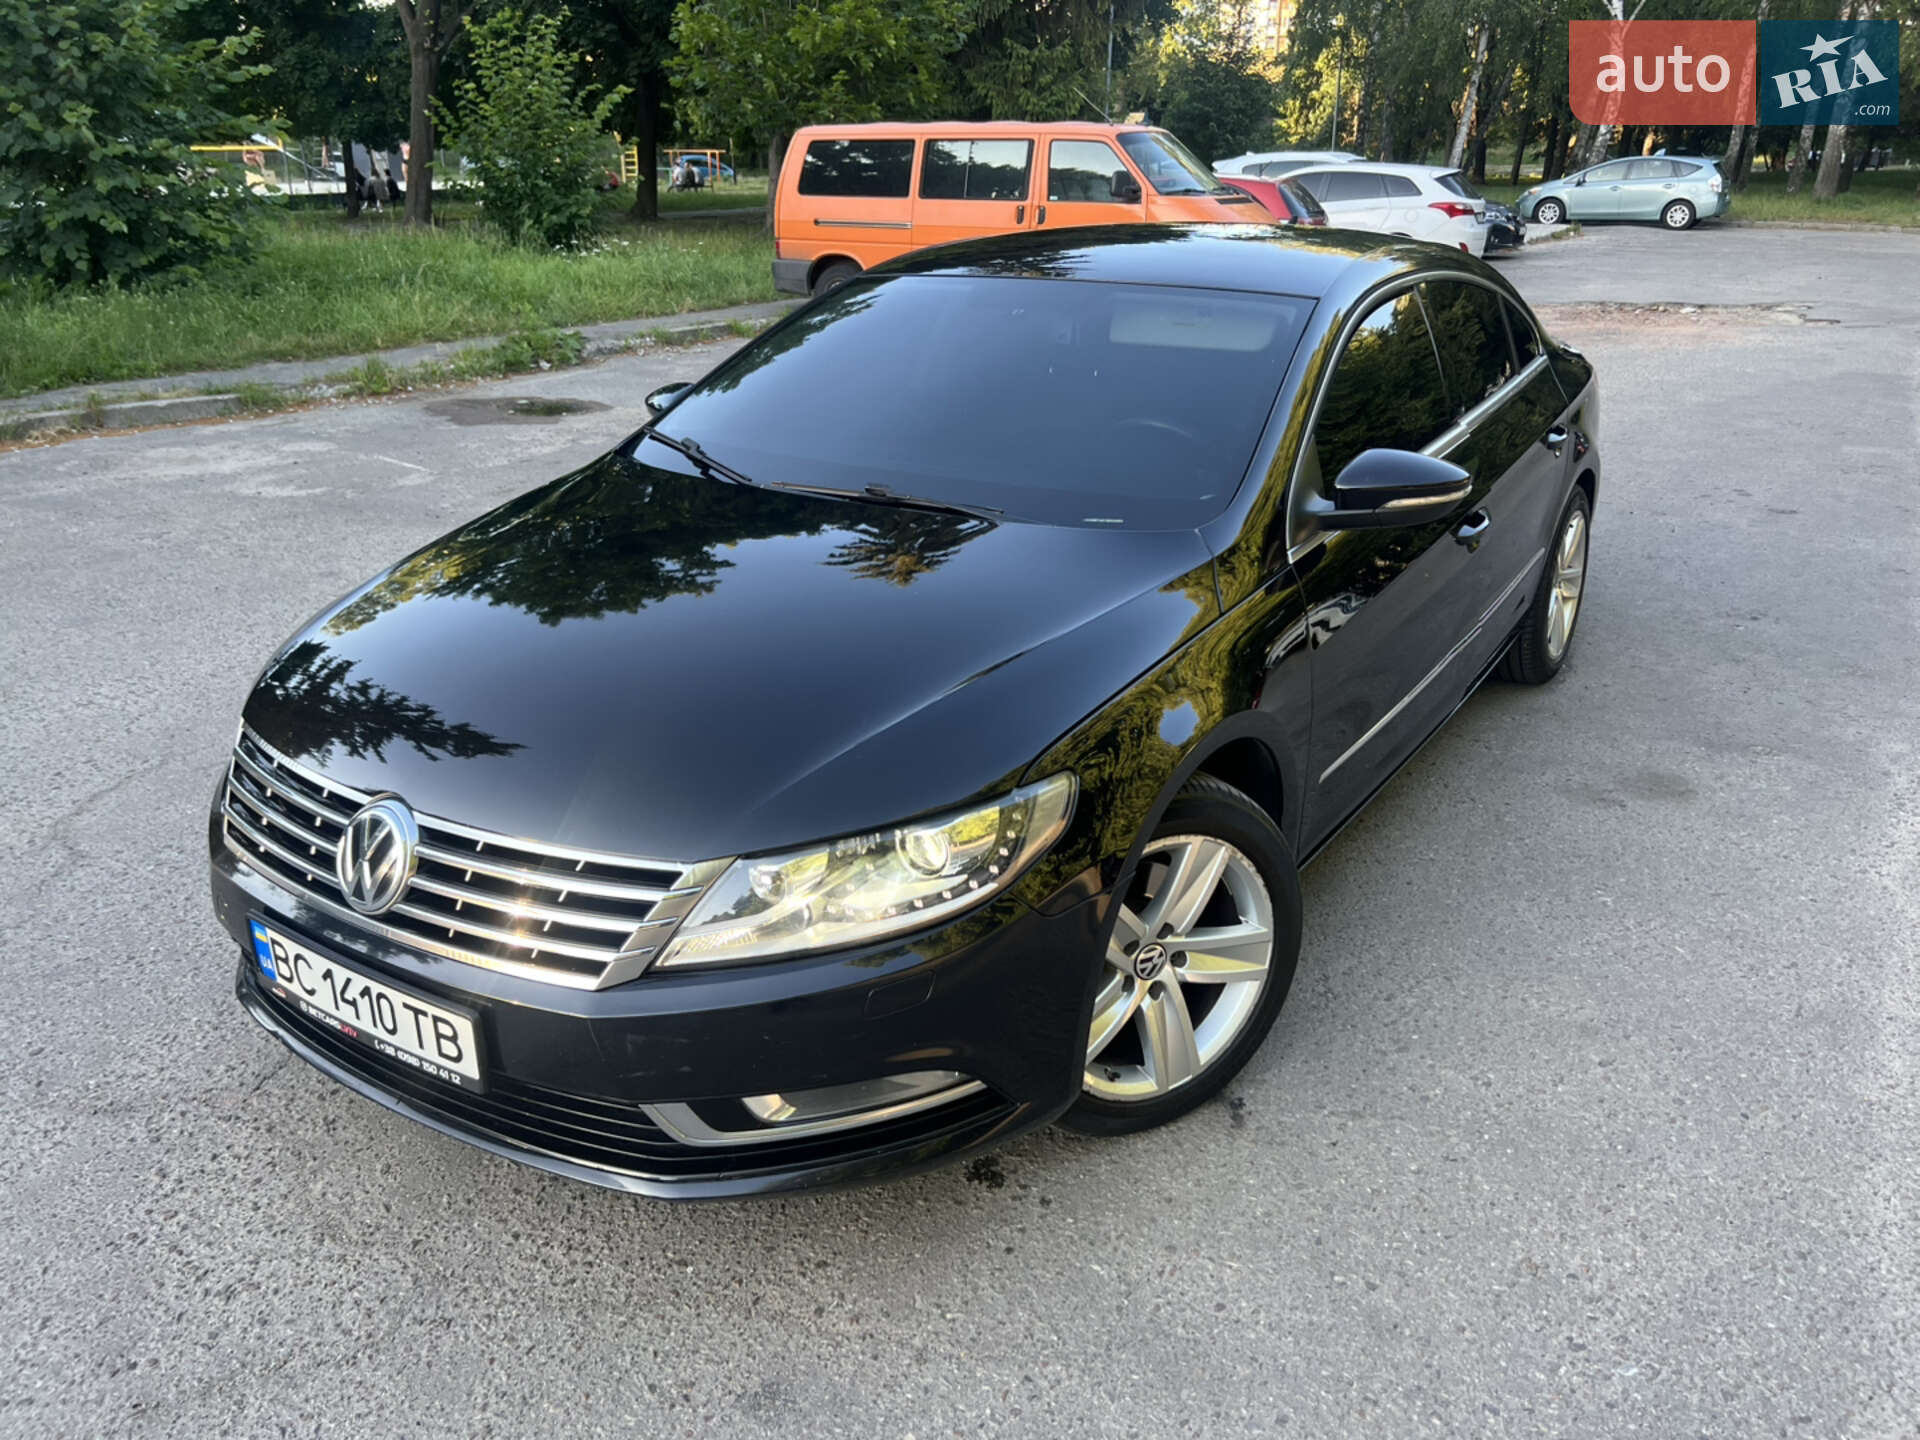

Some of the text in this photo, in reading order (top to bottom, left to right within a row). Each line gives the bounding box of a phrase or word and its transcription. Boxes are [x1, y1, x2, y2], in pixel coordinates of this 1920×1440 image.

[259, 953, 274, 969] UA
[270, 937, 463, 1063] BC 1410 TB
